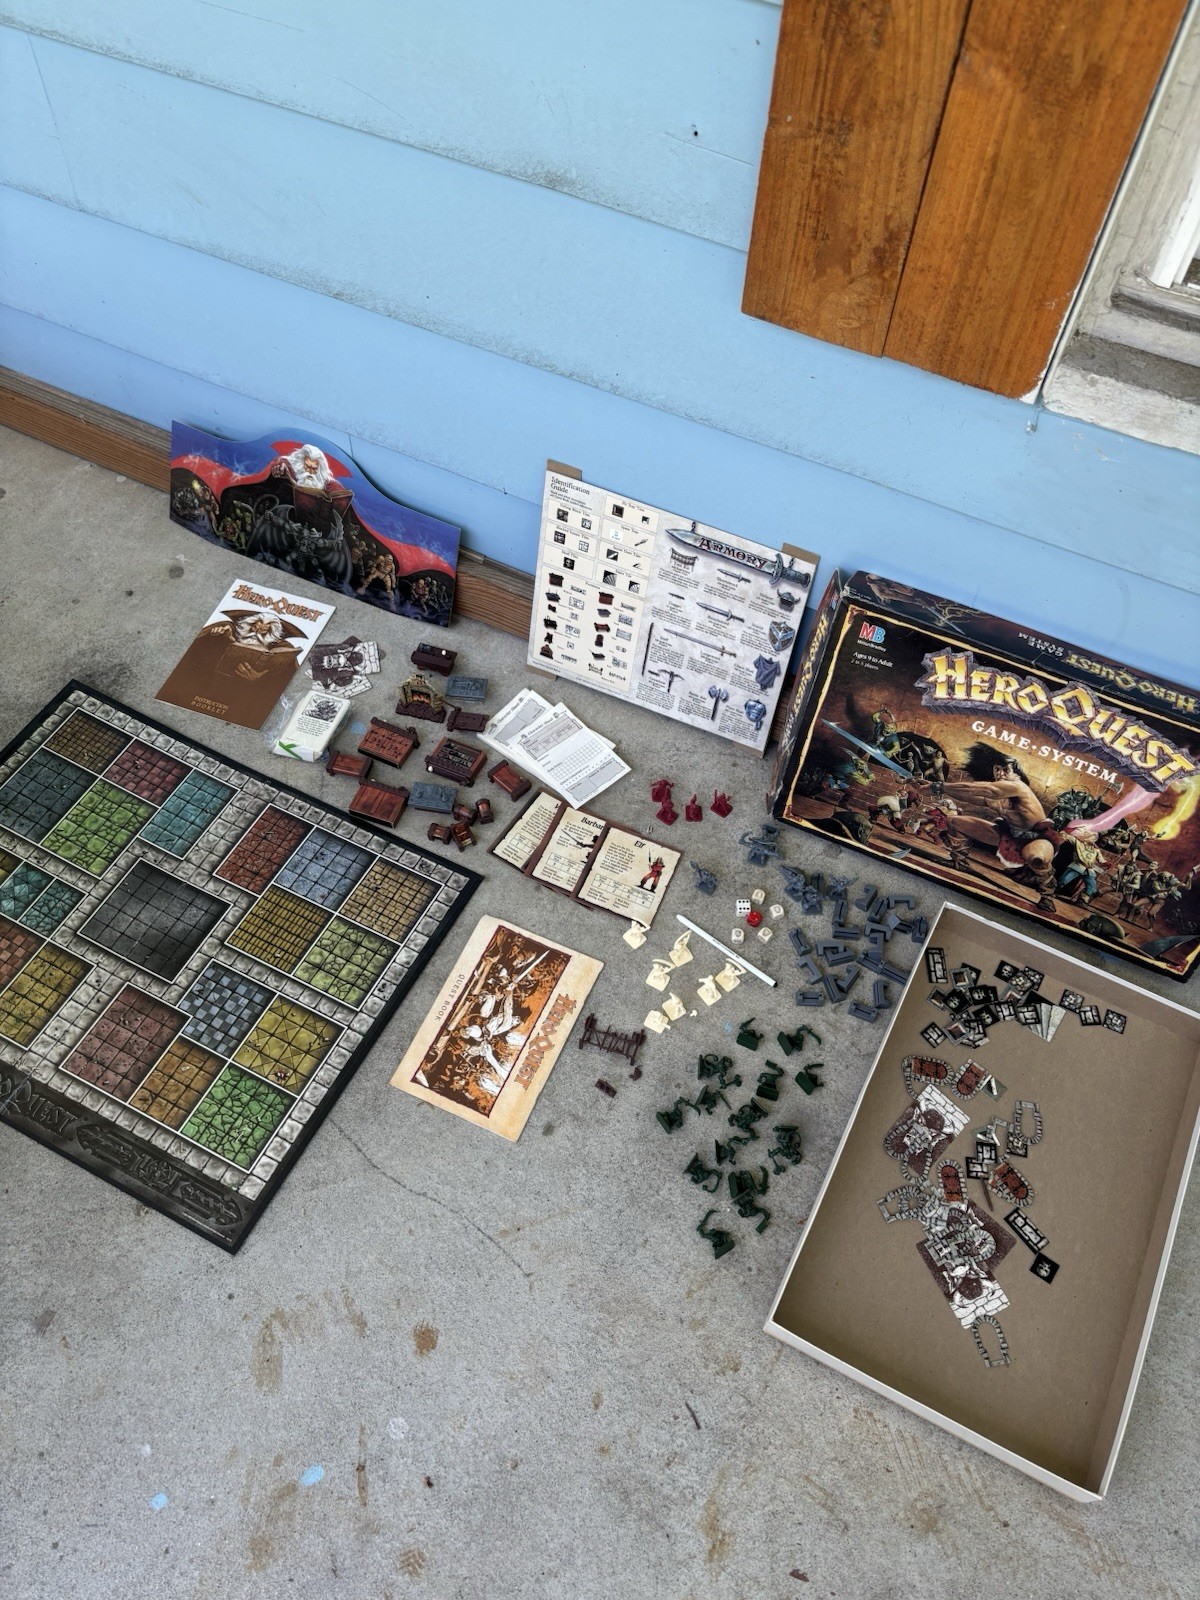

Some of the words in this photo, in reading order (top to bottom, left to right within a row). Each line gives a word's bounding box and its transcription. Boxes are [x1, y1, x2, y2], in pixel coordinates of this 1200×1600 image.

[550, 482, 569, 494] Guide
[551, 476, 590, 496] Identification
[698, 536, 768, 569] ARMORY
[859, 621, 886, 644] MB
[1018, 632, 1065, 652] SYSTEM
[1027, 640, 1064, 657] GAME
[853, 652, 867, 660] Ages
[878, 658, 893, 668] Adult
[864, 662, 879, 671] players
[190, 700, 228, 715] BOOKLET
[194, 695, 230, 711] INSTRUCTION
[930, 654, 1199, 784] HEROQUEST
[971, 720, 1028, 752] GAME
[1037, 744, 1119, 784] SYSTEM
[634, 840, 646, 848] Elf
[449, 974, 466, 1000] QUEST
[435, 1000, 451, 1022] BOOK
